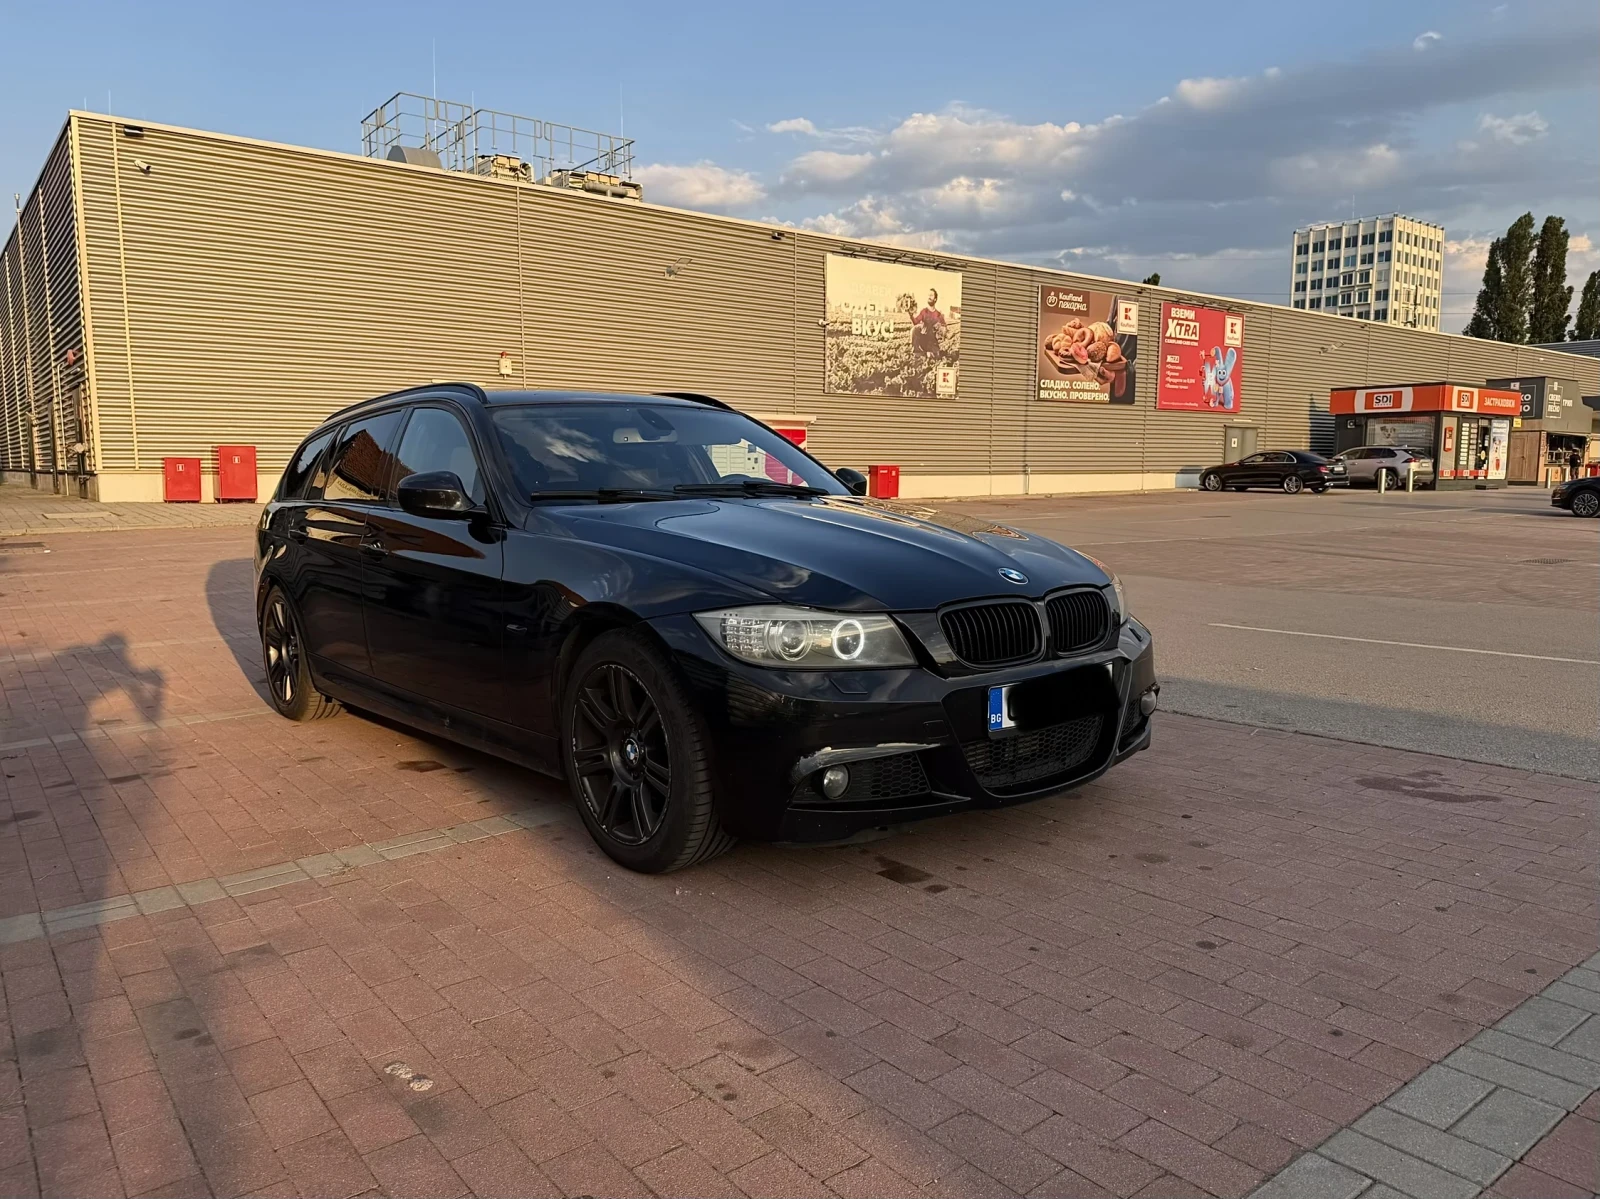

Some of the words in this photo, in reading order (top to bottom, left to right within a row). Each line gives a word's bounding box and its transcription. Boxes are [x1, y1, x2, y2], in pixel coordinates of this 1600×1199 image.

[1059, 292, 1083, 302] Kaufland
[1171, 307, 1196, 320] ВЗЕМИ
[852, 318, 895, 338] ВКУС!
[1165, 318, 1200, 340] XTRA
[1040, 379, 1072, 390] СЛАДКО.
[1072, 381, 1101, 391] СОЛЕНО.
[1039, 390, 1069, 400] ВКУСНО.
[1374, 395, 1392, 404] SDI
[1461, 393, 1470, 403] SDI
[1484, 396, 1516, 408] ЗАСТРАХОВКИ
[990, 713, 1002, 724] BG
